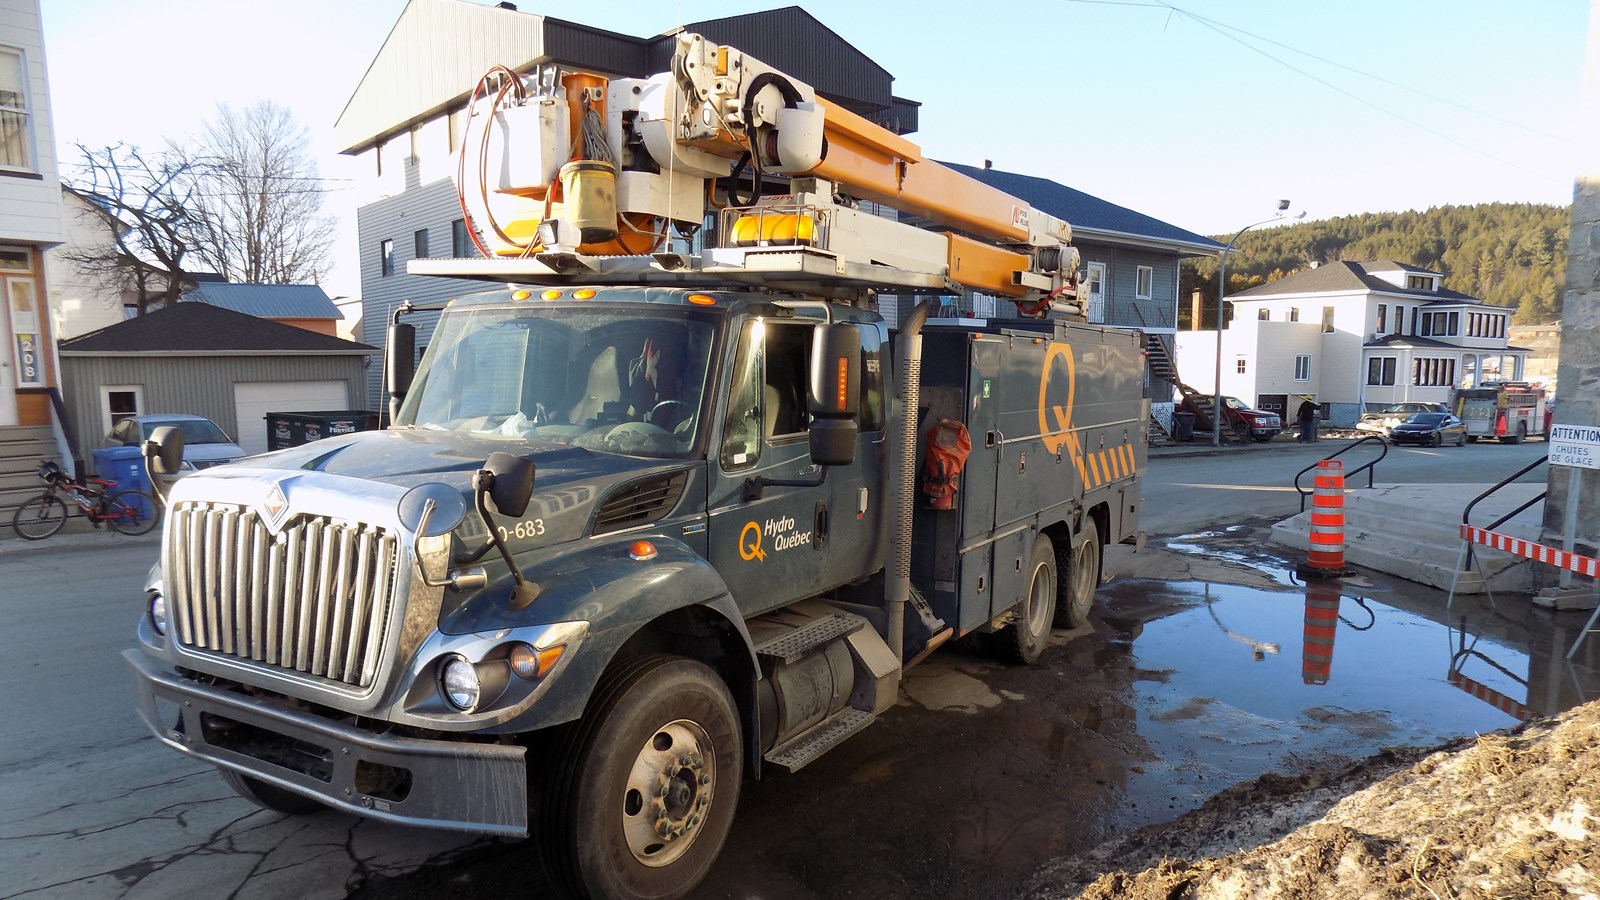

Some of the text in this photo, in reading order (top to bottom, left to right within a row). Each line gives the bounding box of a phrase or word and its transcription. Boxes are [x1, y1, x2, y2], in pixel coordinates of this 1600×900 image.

[22, 341, 35, 377] 208
[1552, 427, 1600, 442] ATTENTION
[1555, 445, 1589, 456] CHUTES
[1551, 454, 1593, 466] DE GLACE
[764, 515, 795, 537] Hydro
[774, 531, 812, 552] Québec
